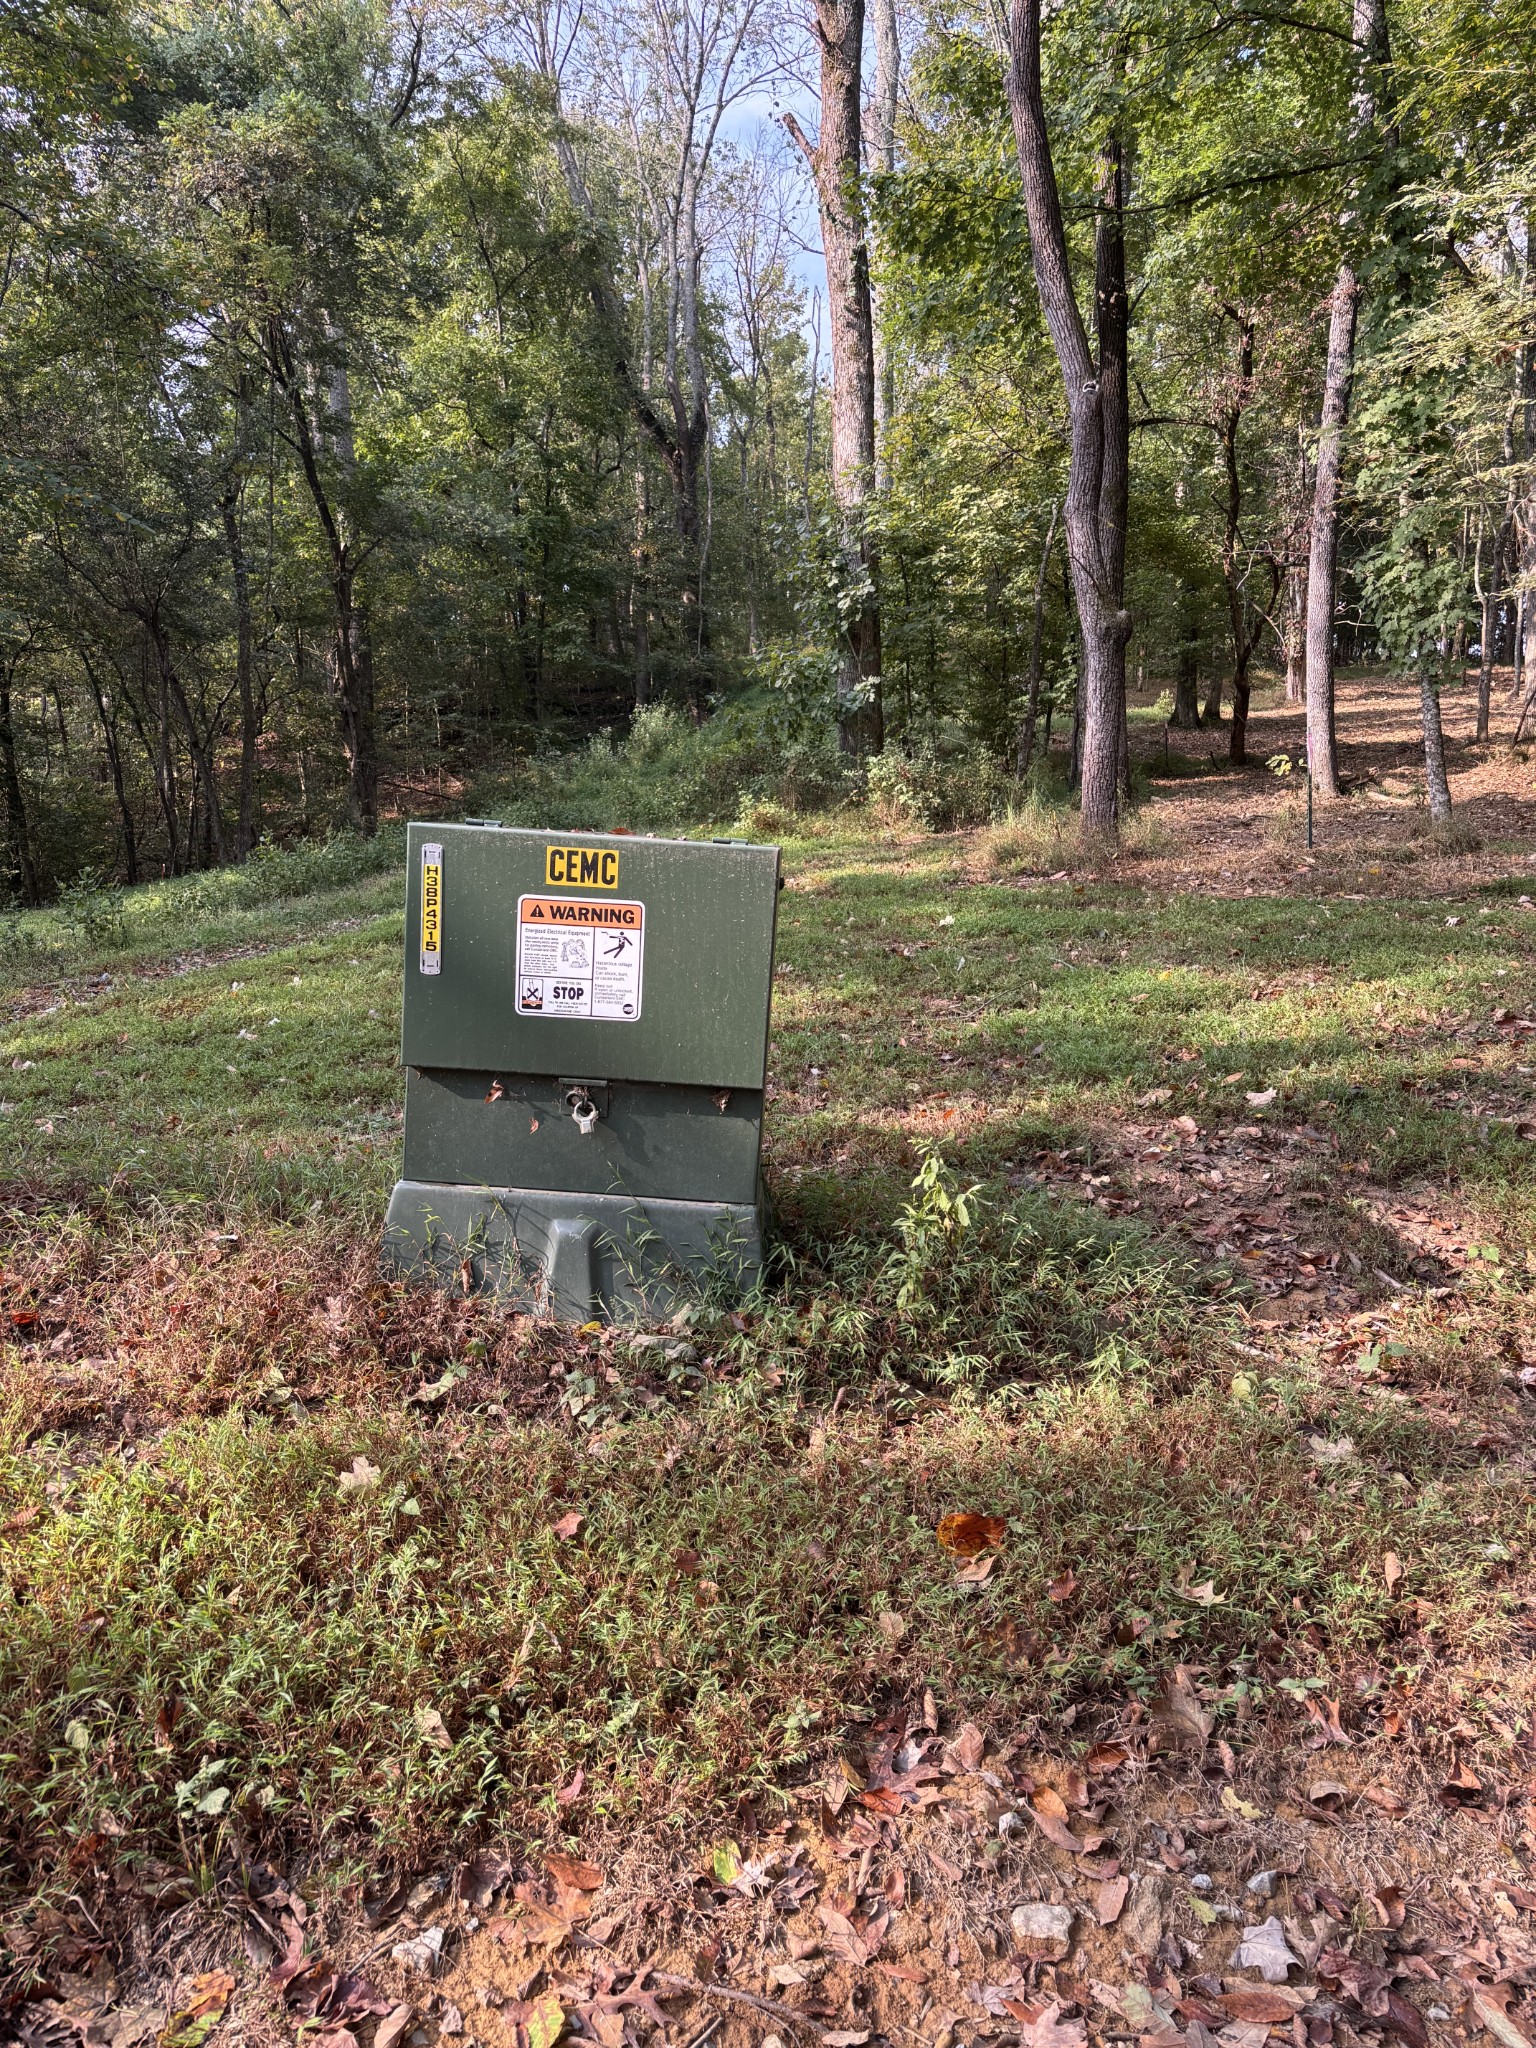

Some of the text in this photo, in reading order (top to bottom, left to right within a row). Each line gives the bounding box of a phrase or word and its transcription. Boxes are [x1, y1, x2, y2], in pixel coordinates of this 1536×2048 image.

[549, 849, 616, 885] CEMC
[425, 866, 438, 952] H38P4315
[549, 905, 635, 924] WARNING
[553, 986, 584, 1000] STOP
